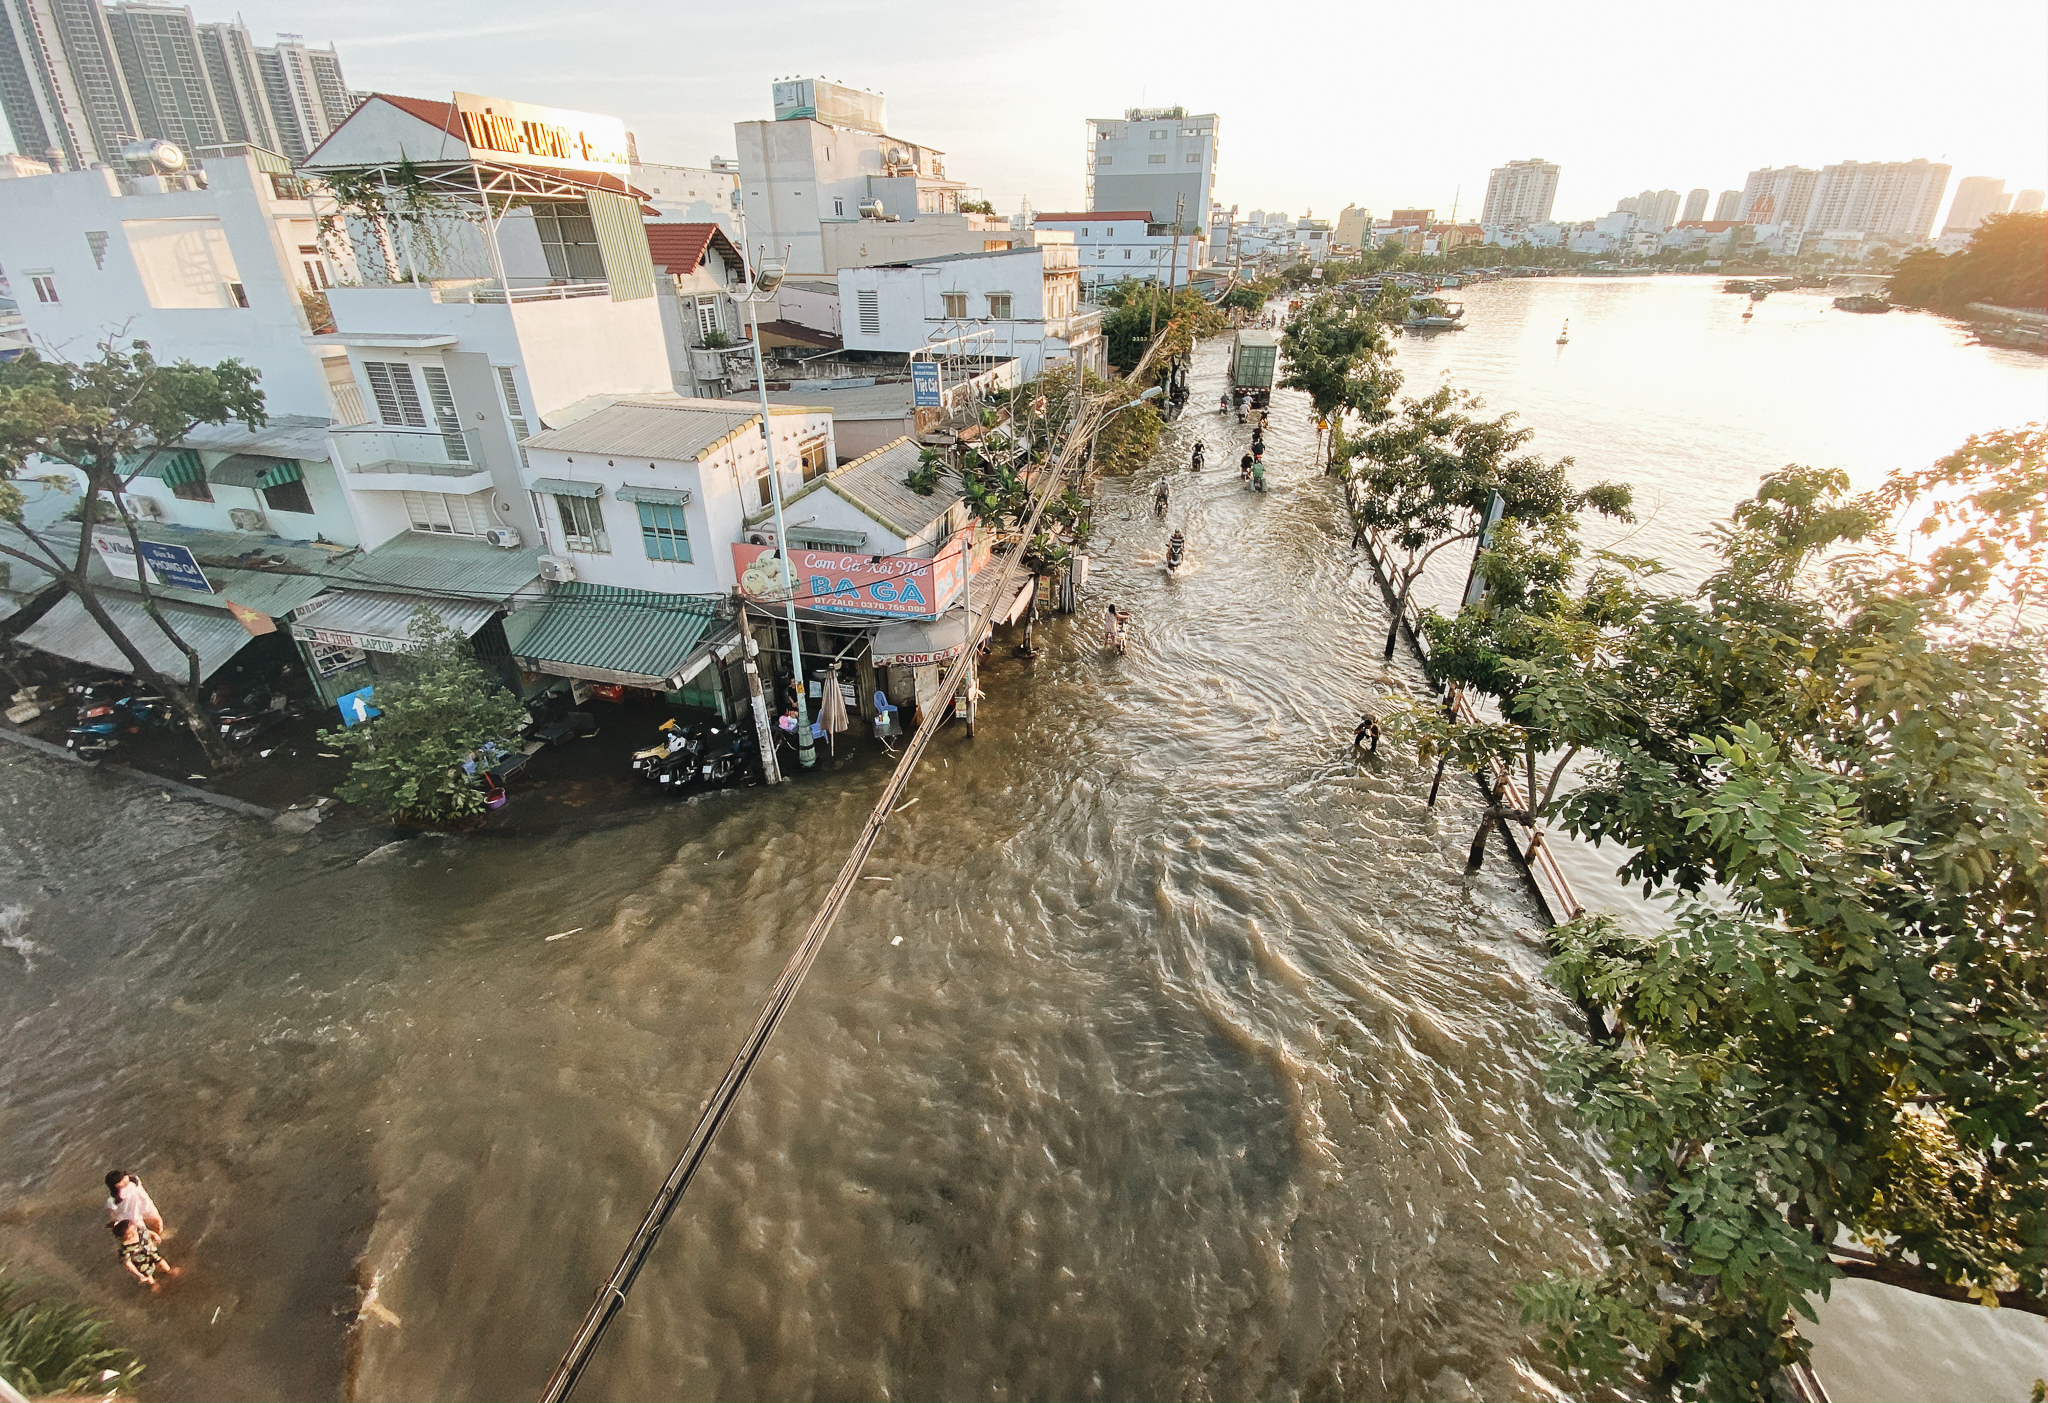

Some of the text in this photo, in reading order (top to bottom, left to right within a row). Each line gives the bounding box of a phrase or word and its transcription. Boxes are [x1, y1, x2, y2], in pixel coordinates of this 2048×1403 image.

[840, 556, 862, 572] Gà
[810, 575, 860, 599] BA
[869, 577, 926, 605] GÀ
[360, 637, 394, 651] LAPTOP
